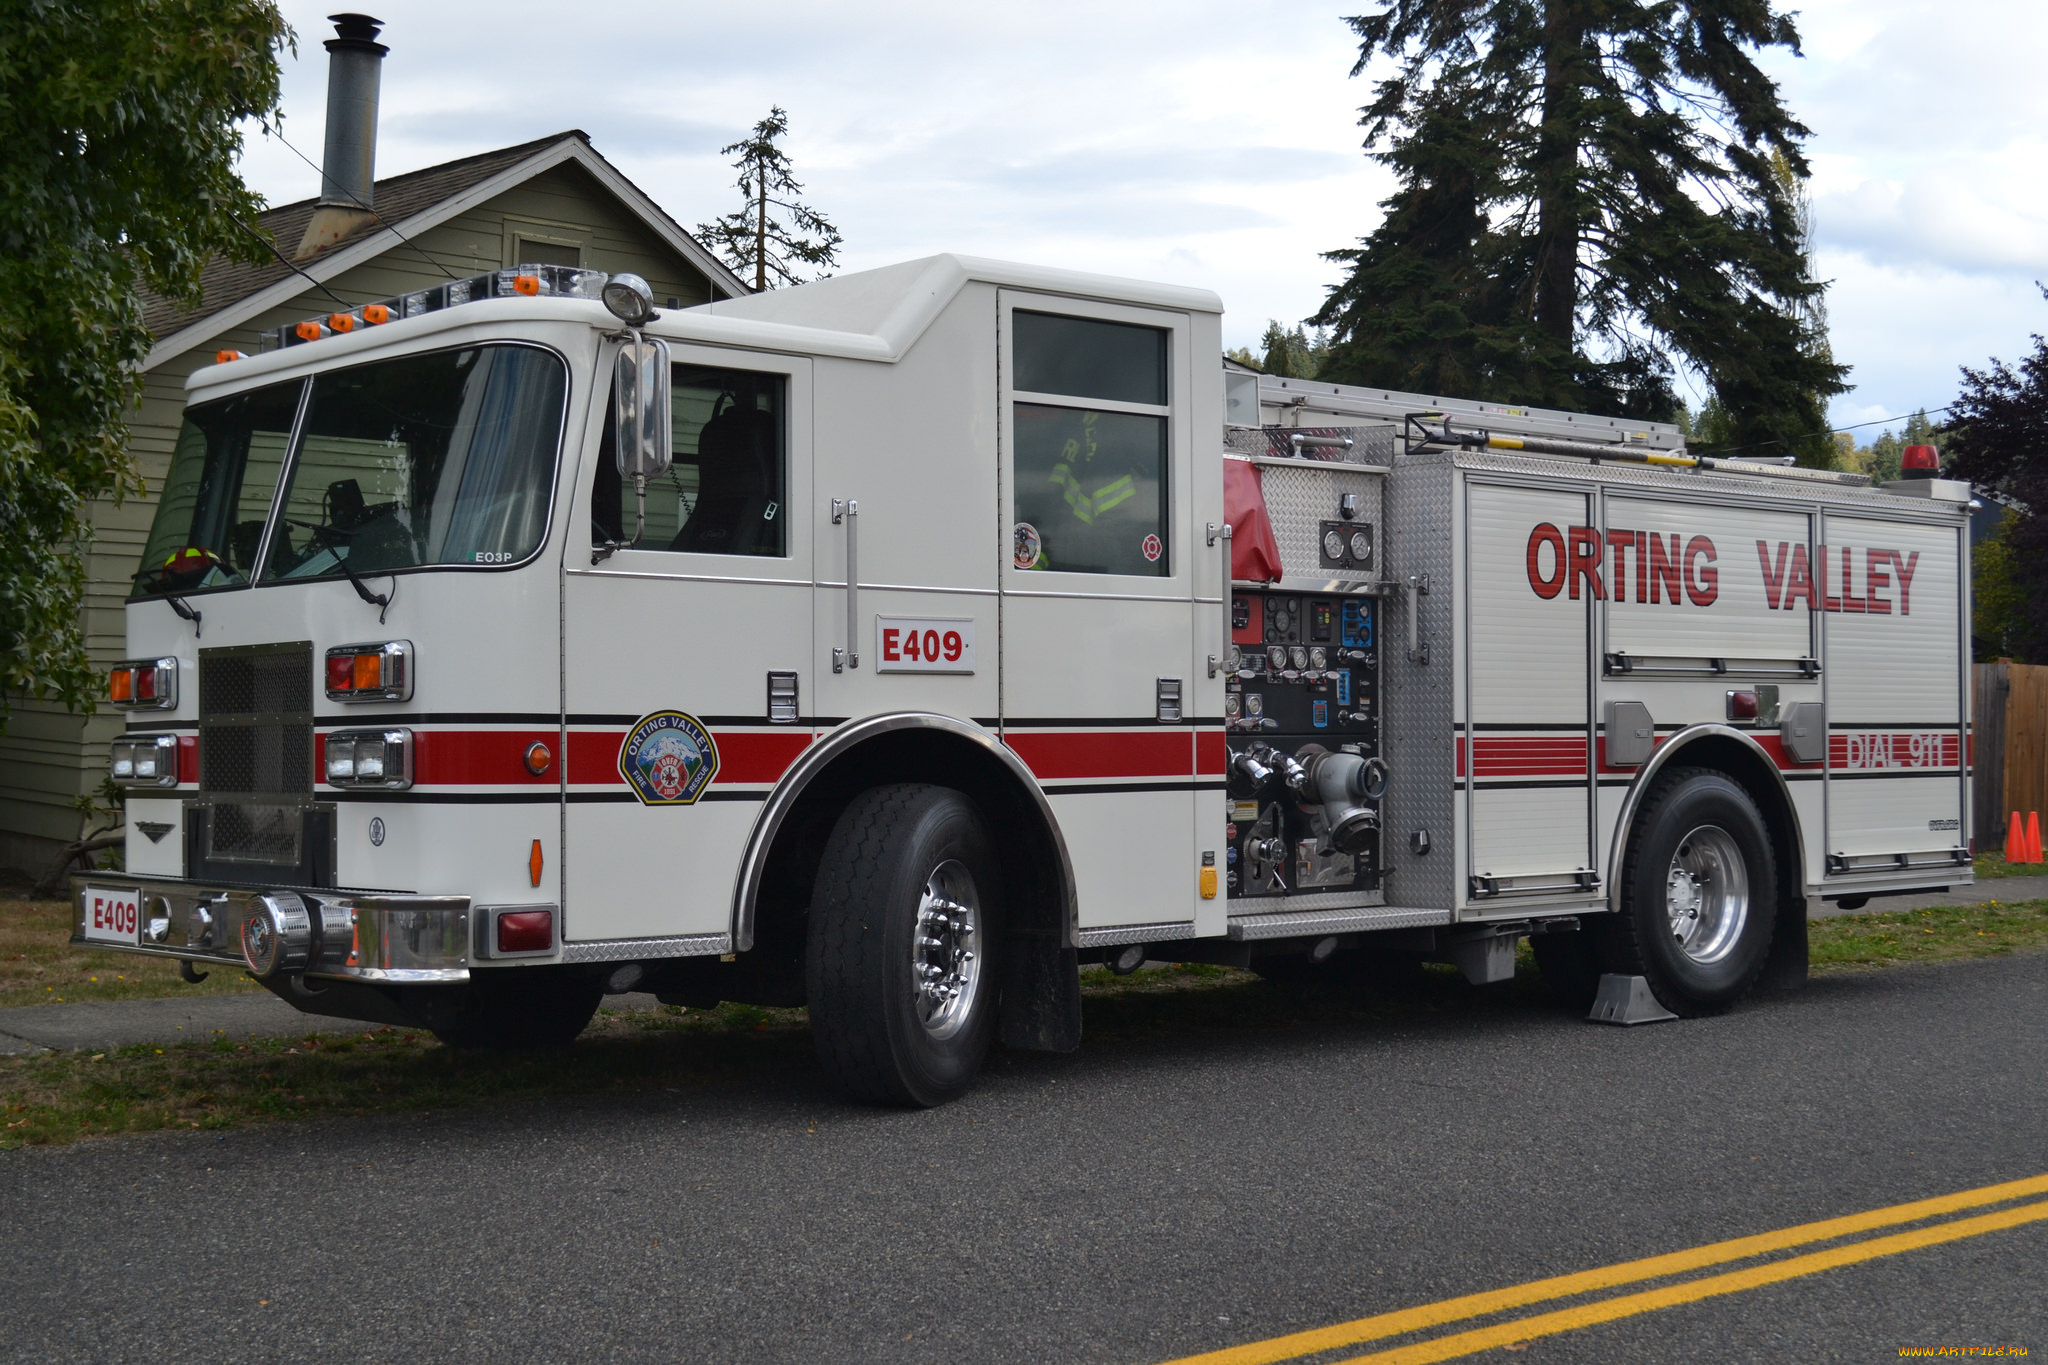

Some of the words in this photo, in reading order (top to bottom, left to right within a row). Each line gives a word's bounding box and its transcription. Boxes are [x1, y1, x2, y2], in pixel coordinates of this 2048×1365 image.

[1526, 522, 1719, 607] ORTING
[1756, 540, 1920, 615] VALLEY
[883, 628, 962, 662] E409
[628, 717, 667, 756] ORTING
[671, 717, 710, 754] VALLEY
[1847, 734, 1901, 768] DIAL
[1909, 734, 1943, 767] 911
[632, 770, 647, 788] FIRE
[688, 765, 709, 793] RESCUE
[94, 898, 136, 934] E409
